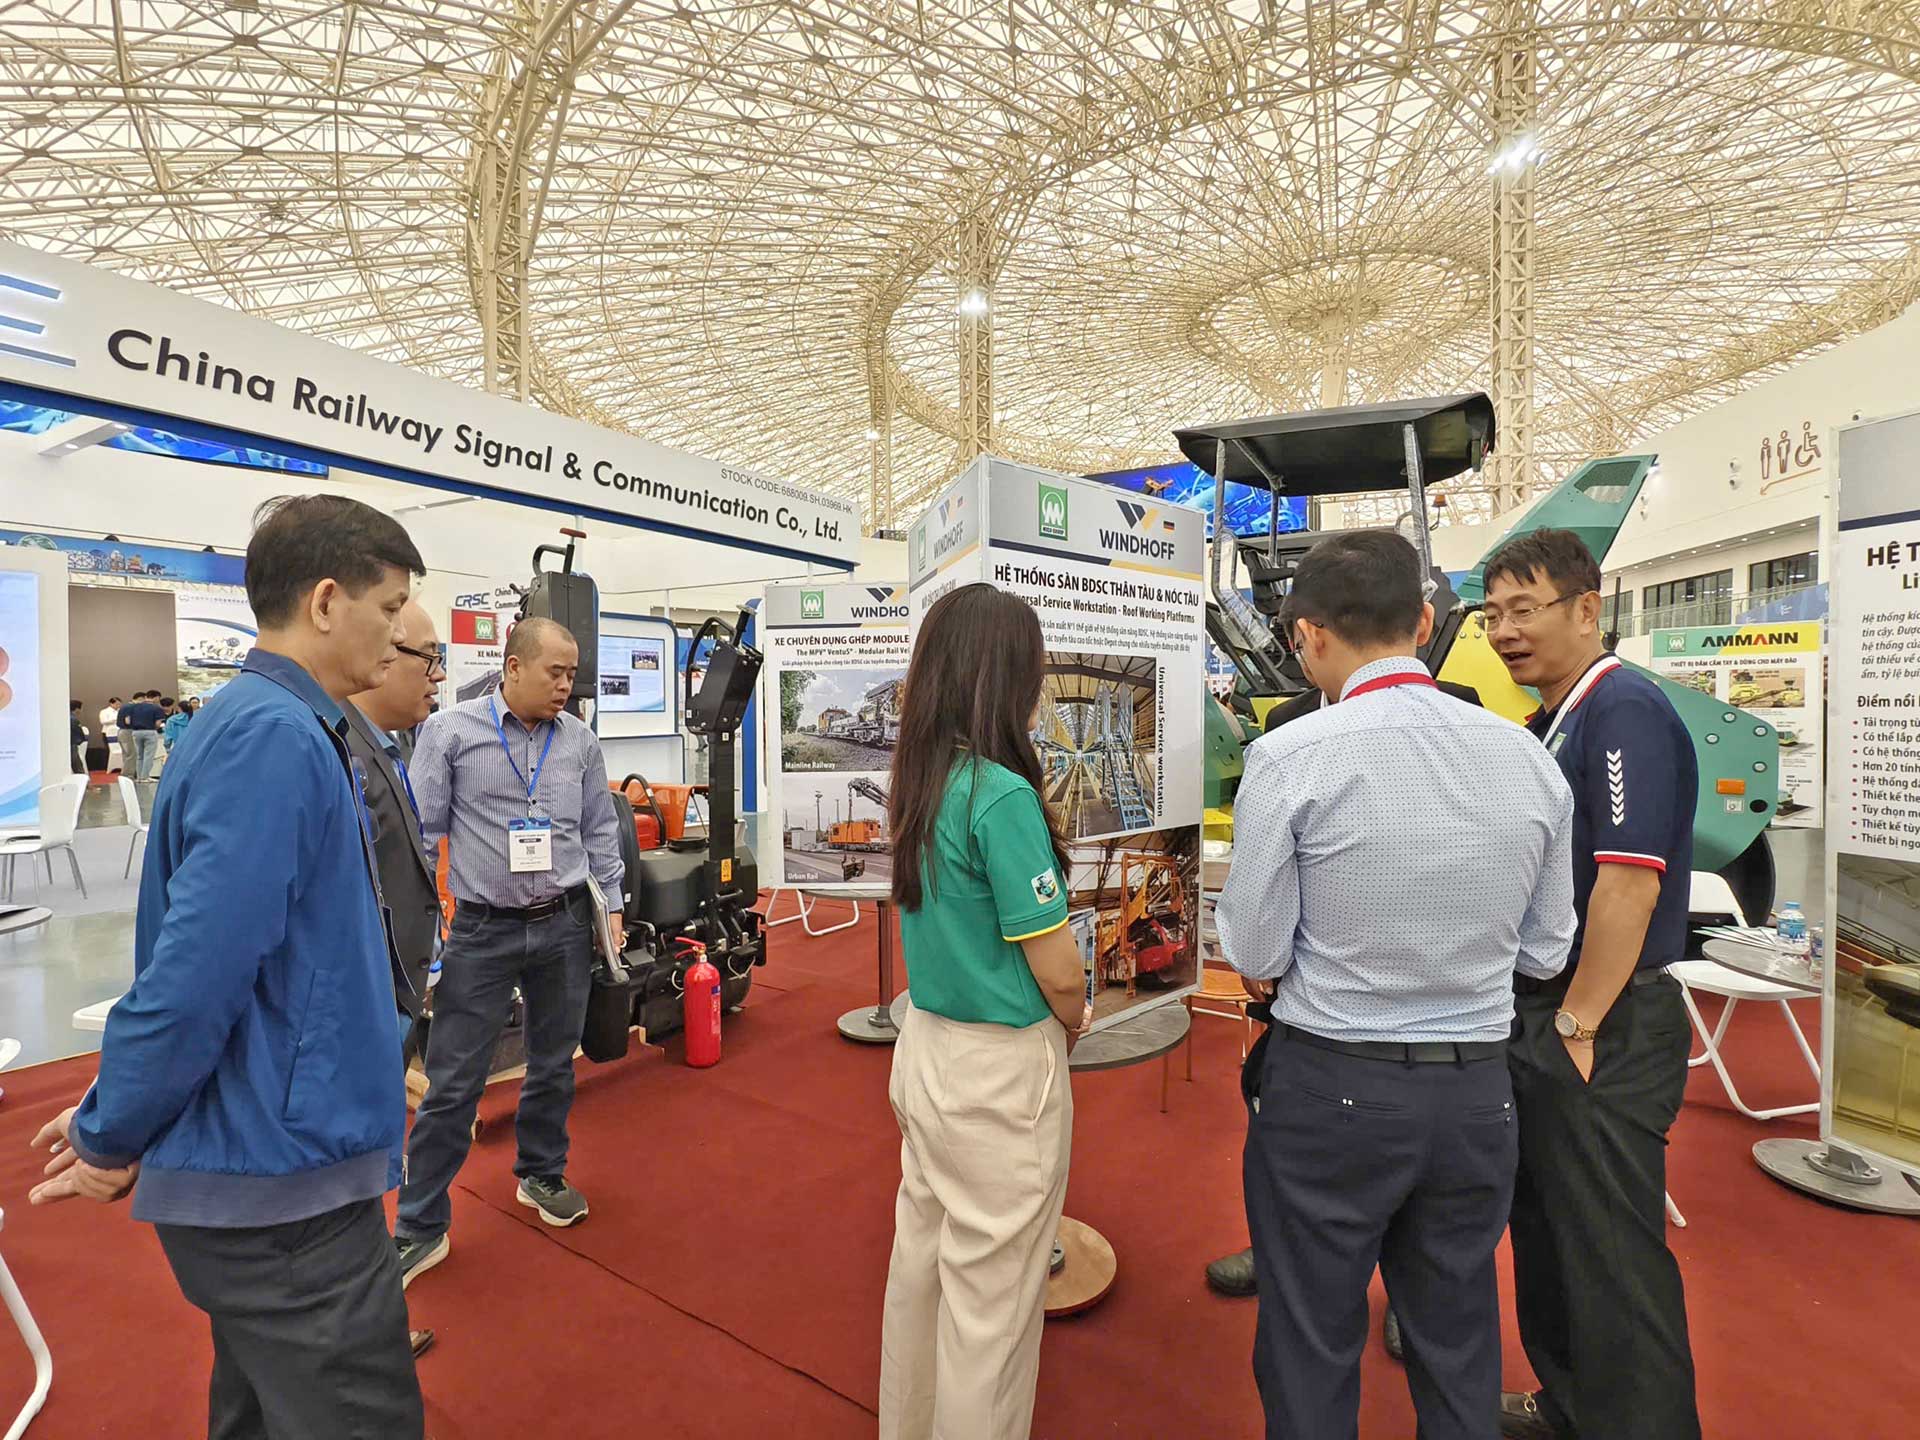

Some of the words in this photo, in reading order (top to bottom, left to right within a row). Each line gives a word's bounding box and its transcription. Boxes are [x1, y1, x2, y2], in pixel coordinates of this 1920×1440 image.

[108, 329, 275, 403] China
[292, 376, 443, 453] Railway
[454, 423, 553, 473] Signal
[562, 452, 583, 480] &
[593, 461, 769, 525] Communication
[776, 507, 808, 539] Co.,
[815, 516, 842, 542] Ltd.
[720, 468, 753, 487] STOCK
[934, 521, 964, 560] WINDHOFF
[1099, 528, 1175, 560] WINDHOFF
[1867, 541, 1900, 570] HỆ
[995, 562, 1012, 587] HỆ
[1013, 565, 1056, 588] THỐNG
[1057, 571, 1080, 591] SÀN
[1081, 577, 1109, 595] BDSC
[1109, 580, 1137, 599] THÂN
[1138, 583, 1155, 601] TÀU
[1156, 588, 1164, 602] &
[1164, 588, 1183, 605] NÓC
[1183, 590, 1199, 607] TÀU
[495, 587, 511, 597] China
[455, 592, 490, 609] CRSC
[1042, 595, 1072, 610] Service
[1072, 599, 1117, 615] Workstation
[1122, 604, 1139, 617] Roof
[1139, 606, 1165, 622] Working
[1166, 610, 1195, 624] Platforms
[1862, 613, 1875, 625] Hệ
[1876, 611, 1906, 624] thống
[1701, 632, 1798, 648] AMMANN
[1862, 628, 1875, 638] tin
[774, 637, 785, 646] XE
[786, 635, 821, 646] CHUYÊN
[822, 635, 847, 647] DỤNG
[848, 634, 871, 645] GHÉP
[873, 635, 910, 644] MODULE
[1861, 641, 1874, 653] hệ
[1875, 640, 1905, 652] thống
[796, 649, 808, 657] The
[886, 647, 899, 655] Rail
[1861, 655, 1874, 665] tối
[1892, 668, 1902, 680] lệ
[1158, 666, 1166, 714] Universal
[1857, 693, 1890, 708] Điểm
[1894, 693, 1915, 708] nổi
[1863, 717, 1877, 728] Tải
[1879, 718, 1907, 730] trọng
[1158, 716, 1166, 754] Service
[1863, 731, 1875, 741] Có
[1877, 731, 1894, 741] thể
[1896, 732, 1913, 744] lắp
[1863, 746, 1875, 756] Có
[1877, 747, 1889, 759] hệ
[785, 761, 811, 770] Mainline
[812, 761, 836, 770] Railway
[1863, 761, 1882, 771] Hơn
[1885, 762, 1898, 772] 20
[1157, 756, 1166, 817] workstation
[1862, 776, 1876, 788] Hệ
[1878, 776, 1909, 790] thống
[1862, 789, 1888, 801] Thiết
[1889, 790, 1902, 802] kế
[1862, 804, 1879, 816] Tùy
[1881, 806, 1906, 819] chọn
[1862, 818, 1887, 830] Thiết
[1889, 820, 1901, 832] kế
[1861, 833, 1887, 845] Thiết
[1888, 835, 1899, 848] bị
[788, 872, 805, 880] Urban
[806, 872, 819, 880] Rail
